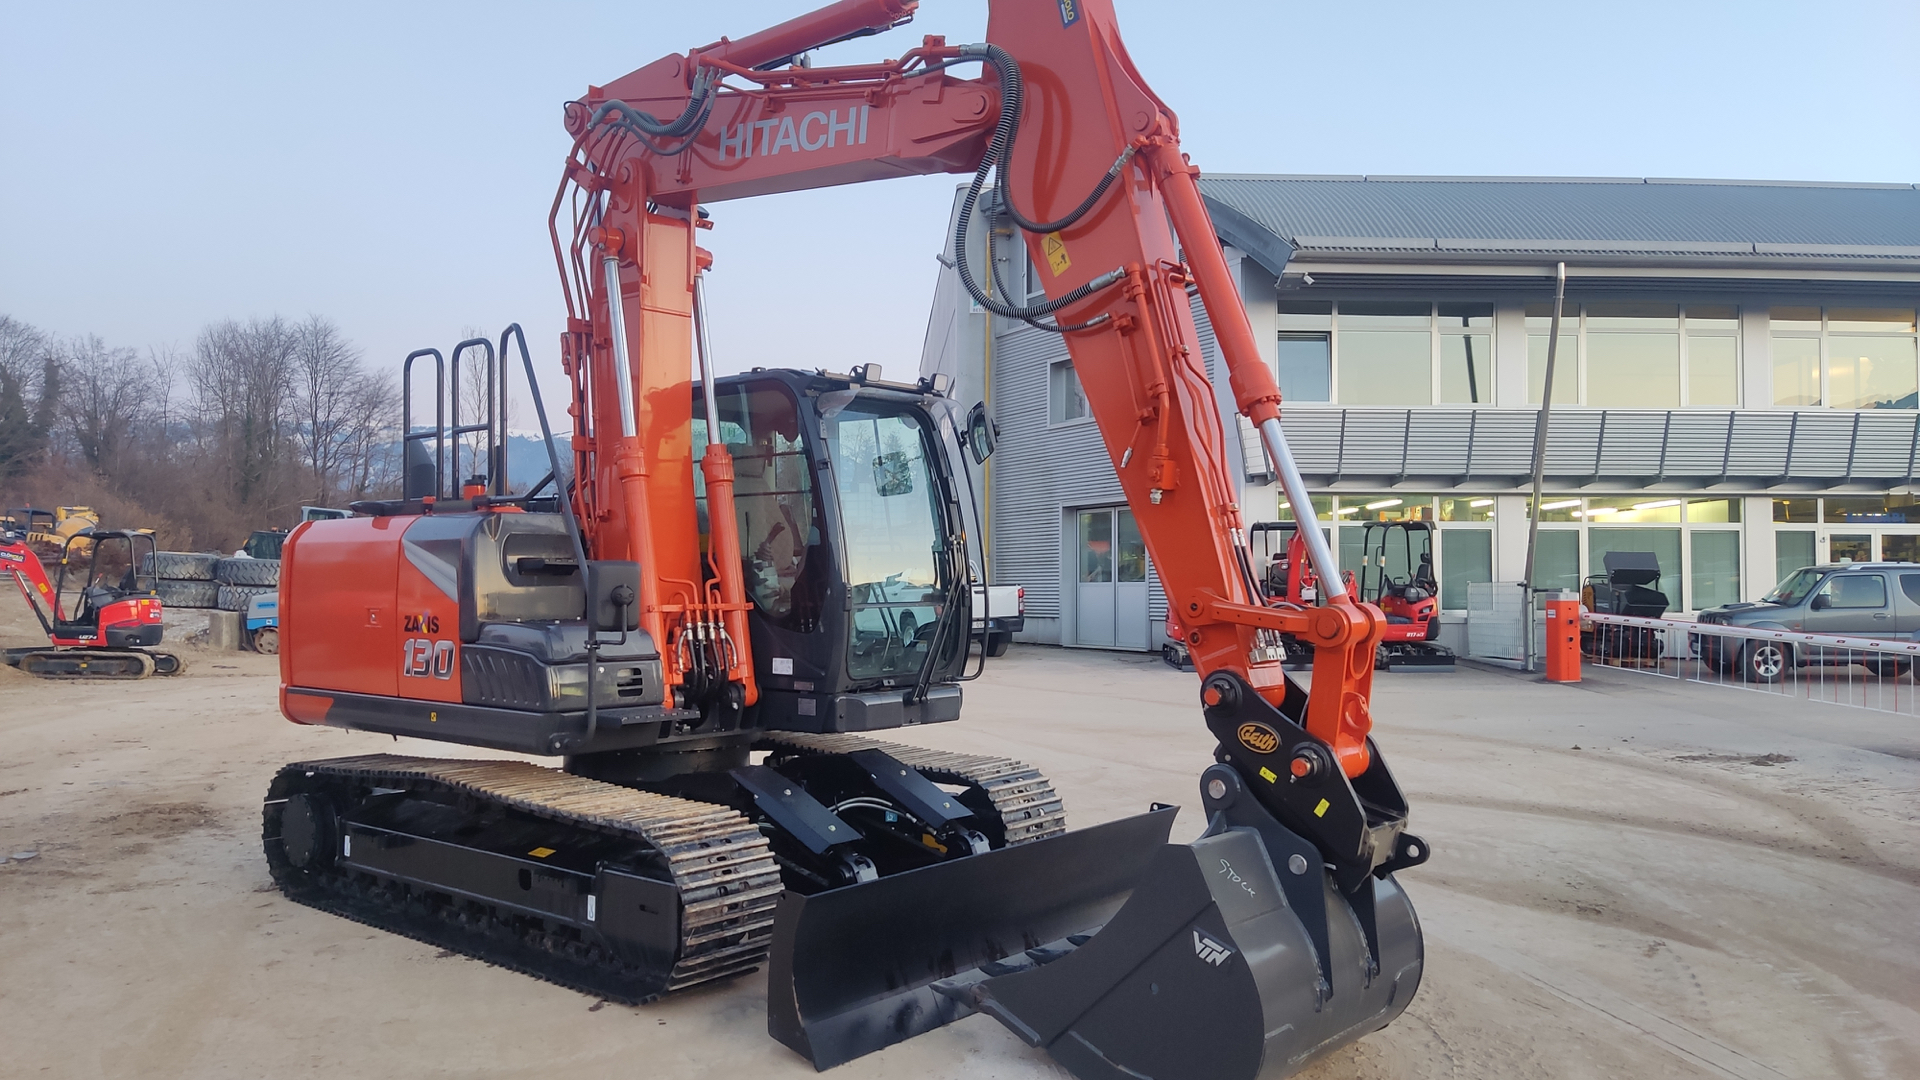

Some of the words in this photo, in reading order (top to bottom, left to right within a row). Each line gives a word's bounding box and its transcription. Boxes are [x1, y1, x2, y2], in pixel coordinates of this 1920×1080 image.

[1064, 0, 1075, 20] OLO
[719, 105, 870, 161] HITACHI
[404, 610, 440, 634] ZAXIS
[403, 638, 456, 680] 130
[1219, 859, 1256, 898] STOCK
[1193, 930, 1231, 967] VTN
